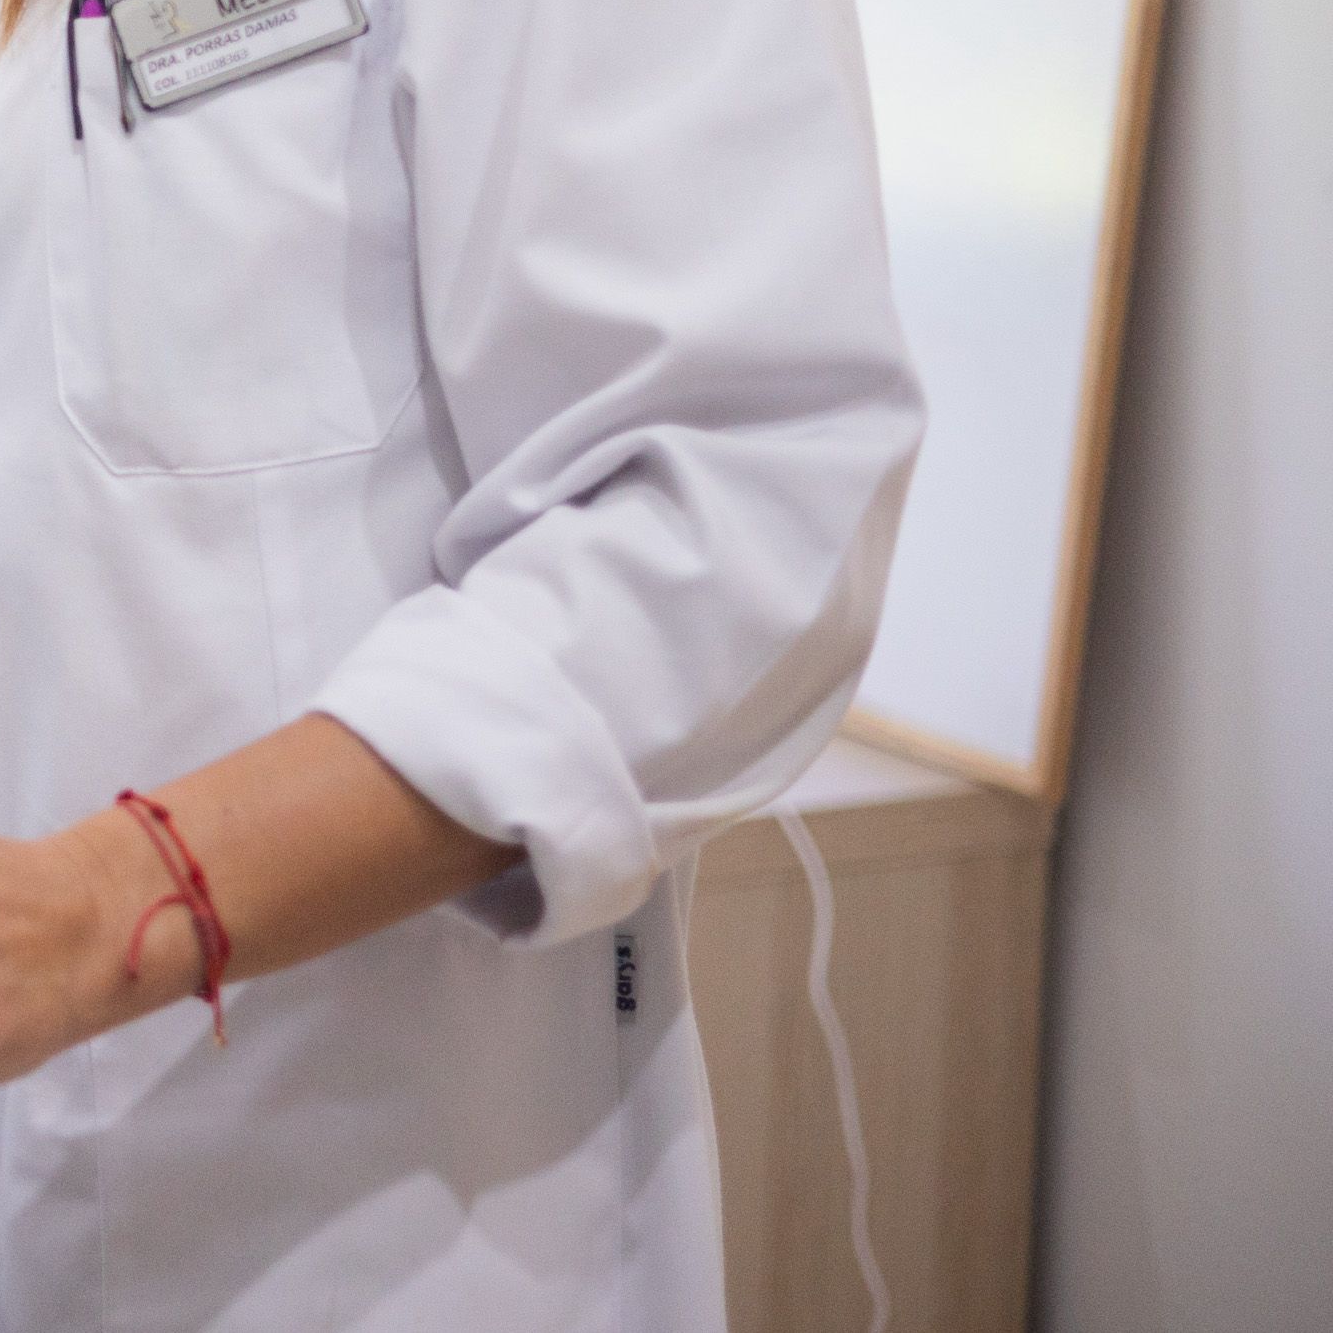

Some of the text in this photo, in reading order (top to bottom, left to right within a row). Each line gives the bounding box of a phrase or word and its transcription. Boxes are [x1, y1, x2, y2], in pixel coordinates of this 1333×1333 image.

[148, 9, 297, 73] DRA. PORRAS DAMAS
